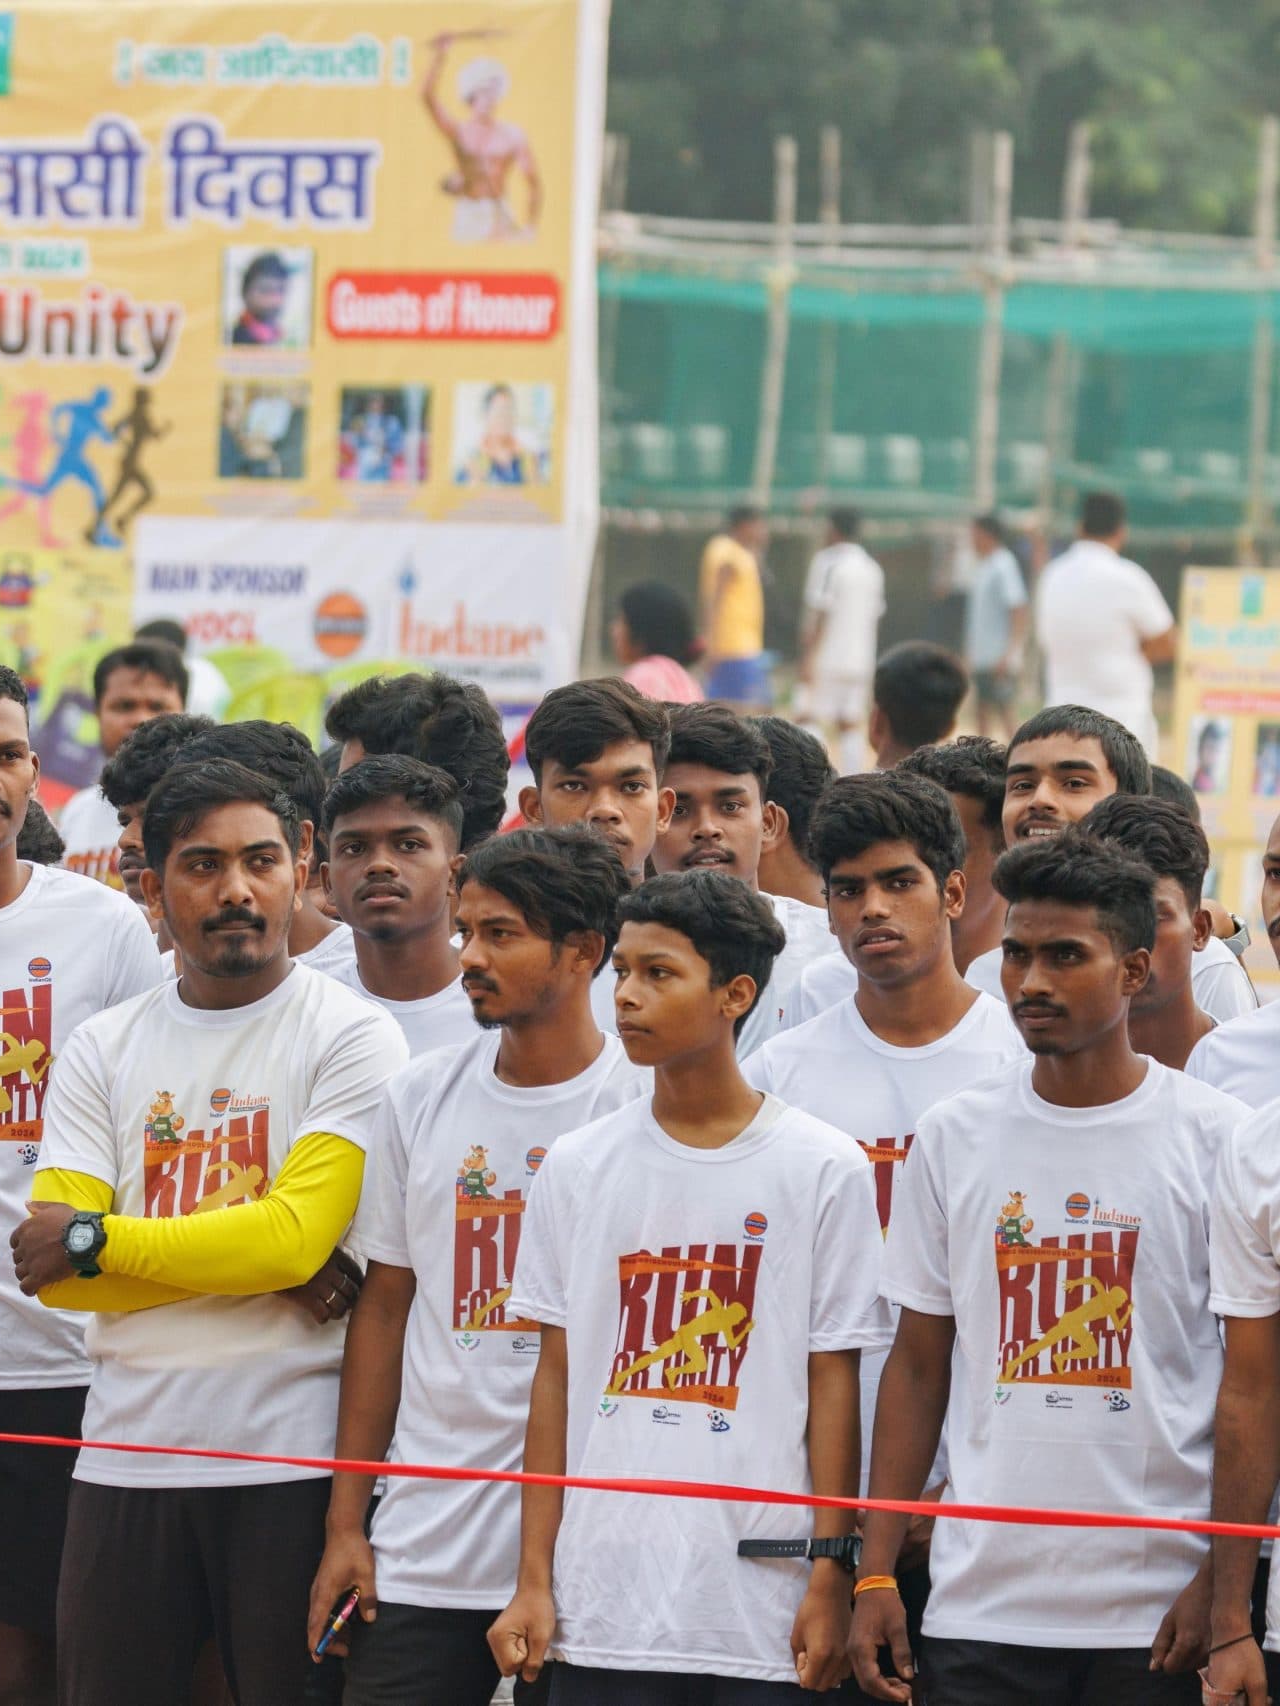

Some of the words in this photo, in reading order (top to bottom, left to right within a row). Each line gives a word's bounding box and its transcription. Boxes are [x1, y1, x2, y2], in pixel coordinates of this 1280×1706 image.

[168, 121, 375, 220] दिवस
[332, 280, 420, 330] Guests
[426, 281, 456, 332] of
[459, 282, 554, 332] Honour
[151, 565, 199, 590] MAIN
[210, 565, 306, 594] SPONSOR
[614, 1244, 763, 1352] RUN
[995, 1231, 1140, 1348] RUN
